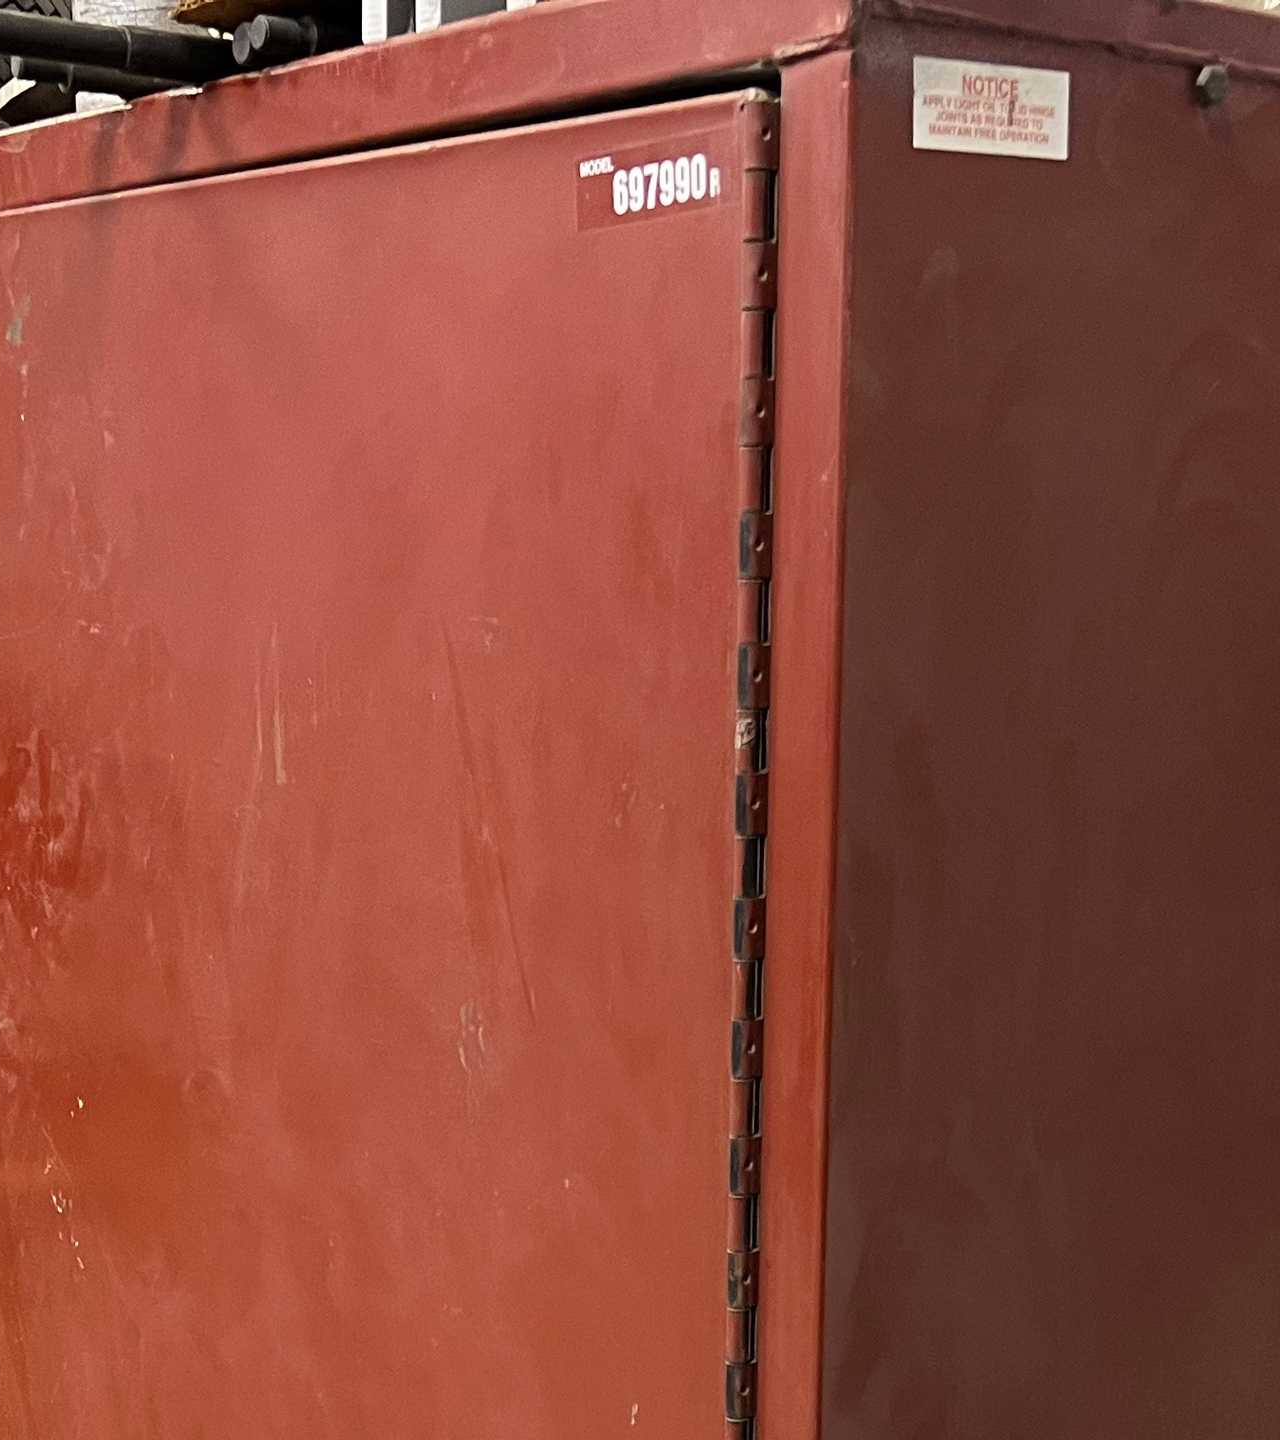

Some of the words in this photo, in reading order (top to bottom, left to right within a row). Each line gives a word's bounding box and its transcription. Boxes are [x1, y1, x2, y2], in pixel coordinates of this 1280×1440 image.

[961, 74, 1019, 100] NOTICE
[984, 114, 1029, 129] REQURED
[579, 156, 615, 178] MODEL
